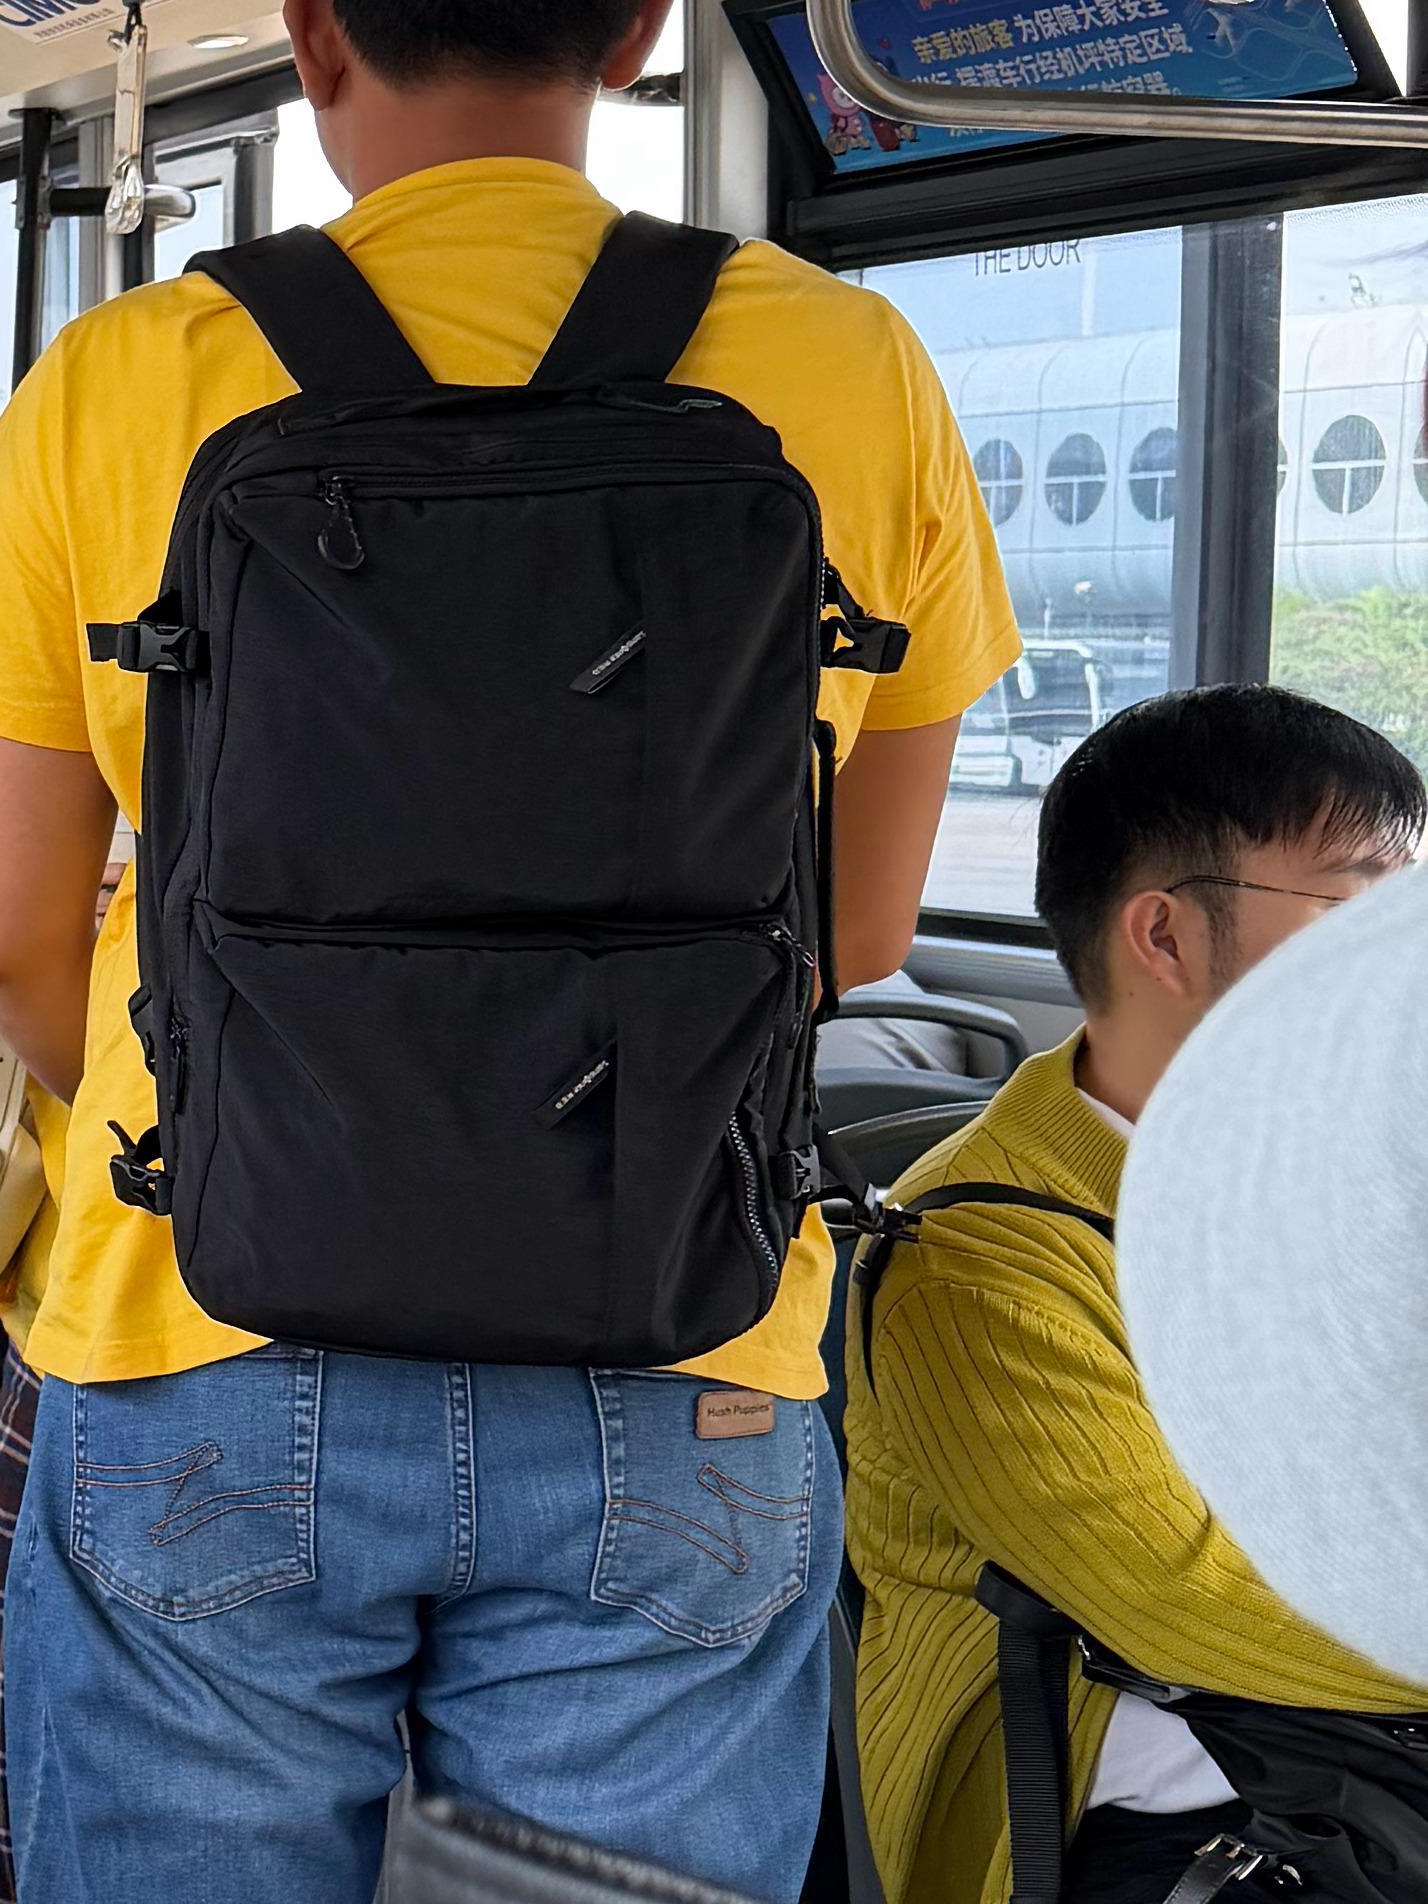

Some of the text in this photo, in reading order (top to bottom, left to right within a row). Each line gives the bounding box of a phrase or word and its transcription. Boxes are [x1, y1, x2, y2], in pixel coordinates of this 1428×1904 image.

[911, 19, 1015, 64] 亲爱的旅客
